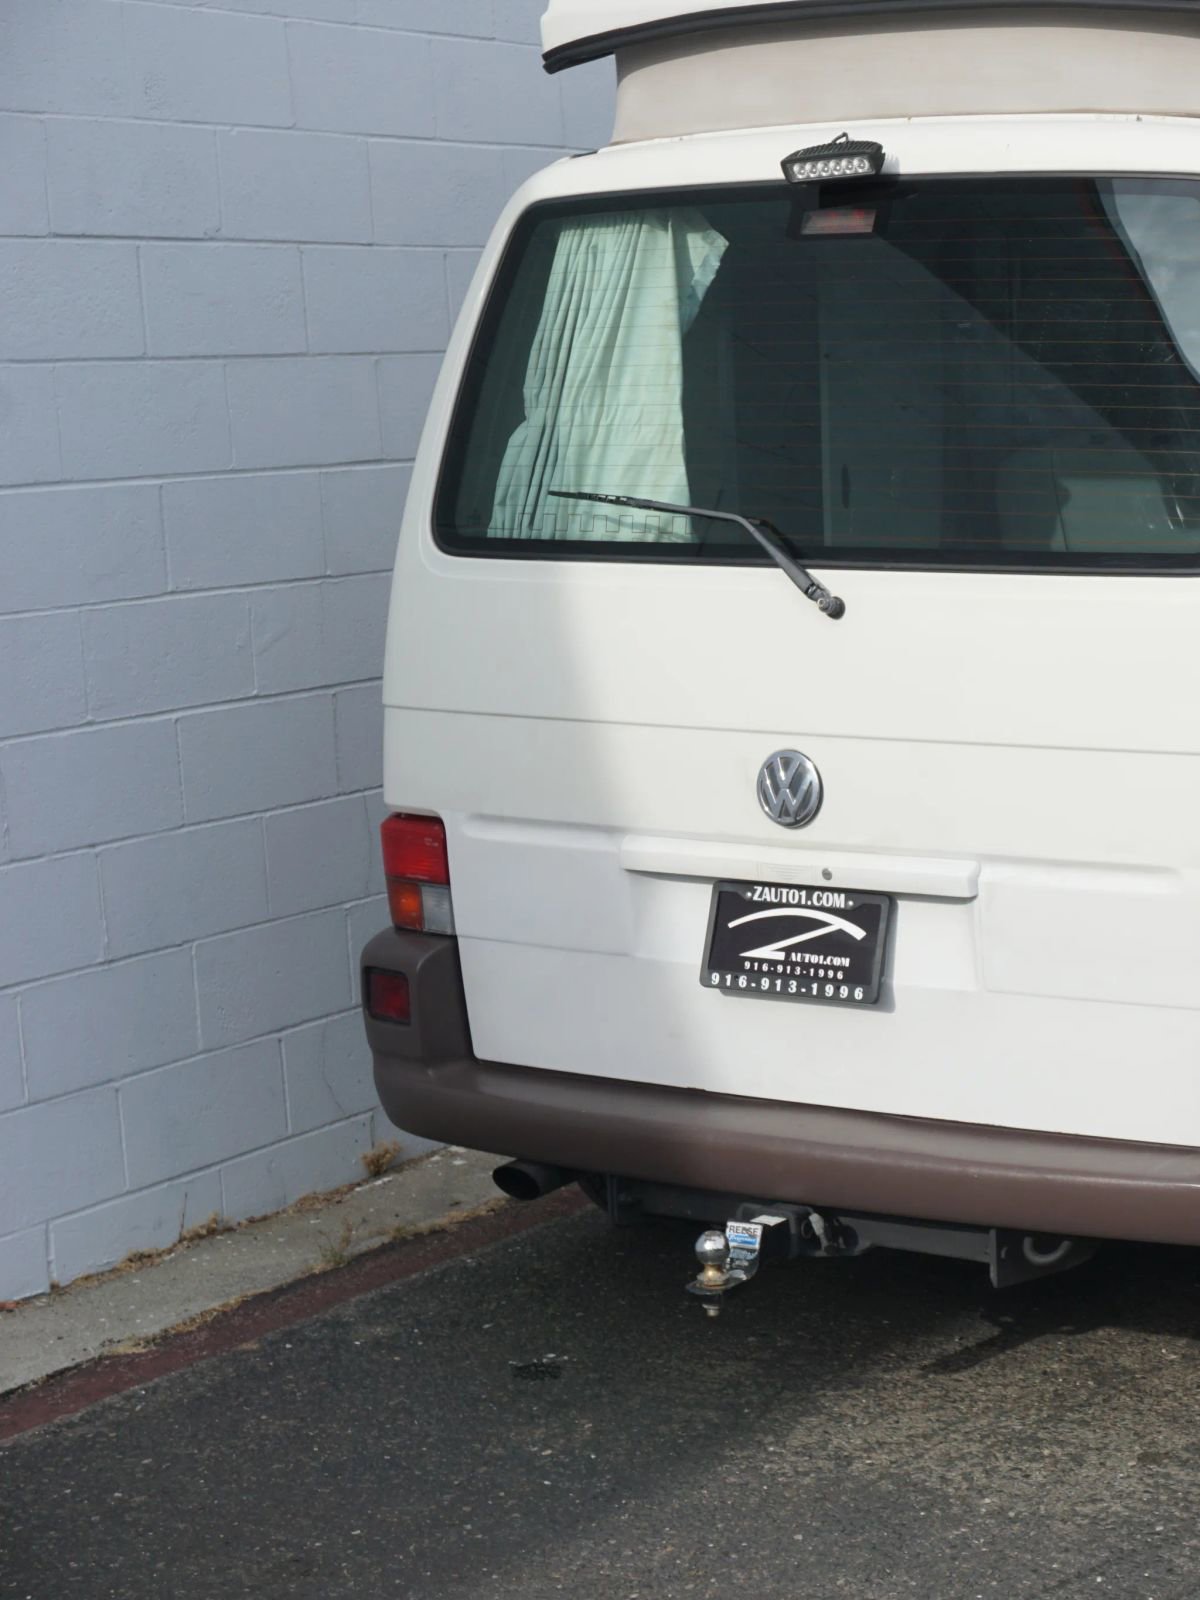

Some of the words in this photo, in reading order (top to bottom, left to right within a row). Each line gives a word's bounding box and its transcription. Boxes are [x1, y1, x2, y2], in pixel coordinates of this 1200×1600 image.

[752, 886, 846, 908] ZAUTO1.COM
[789, 952, 850, 967] AUTO1.COM
[744, 961, 844, 980] 916-913-1996
[711, 972, 864, 1001] 916-913-1996
